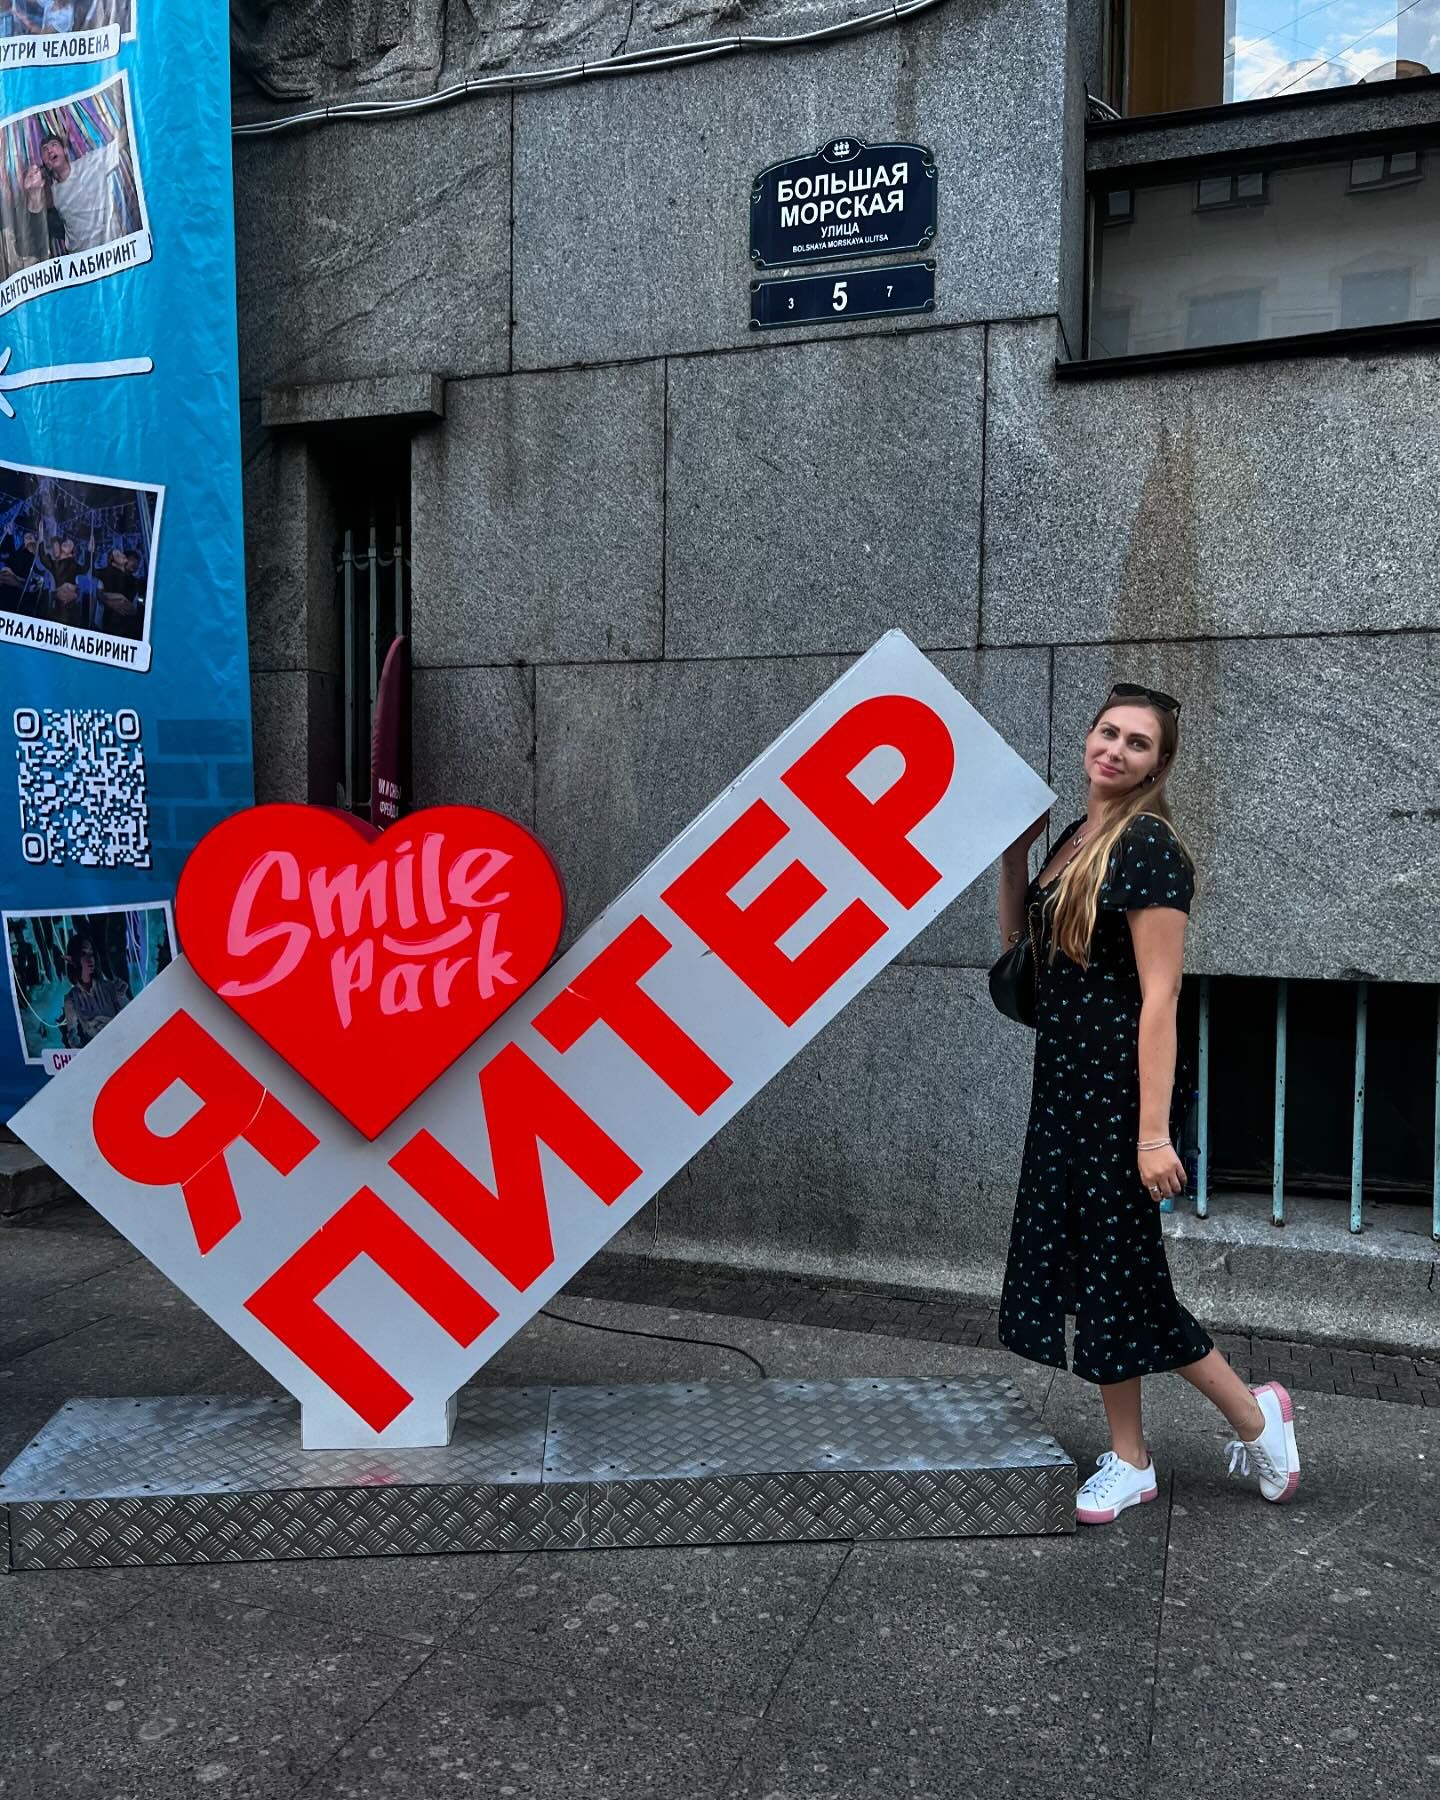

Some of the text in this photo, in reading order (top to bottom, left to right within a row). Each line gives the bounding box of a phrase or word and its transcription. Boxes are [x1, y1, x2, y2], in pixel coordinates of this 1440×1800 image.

[0, 34, 110, 62] УТРИ ЧЕЛОВЕКА
[777, 162, 908, 203] БОЛЬШАЯ
[781, 190, 904, 228] МОРСКАЯ
[792, 233, 889, 253] BOLSHAYA MORSKAYA ULITSA
[820, 222, 860, 238] УЛИЦА
[69, 240, 137, 278] ЛАБИРИНТ
[788, 281, 894, 311] 3 5 7
[71, 634, 138, 663] ЛАБИРИНТ
[217, 832, 514, 997] Smile
[331, 912, 518, 1029] park
[243, 694, 956, 1434] ПИТЕР
[93, 1008, 321, 1257] Я
